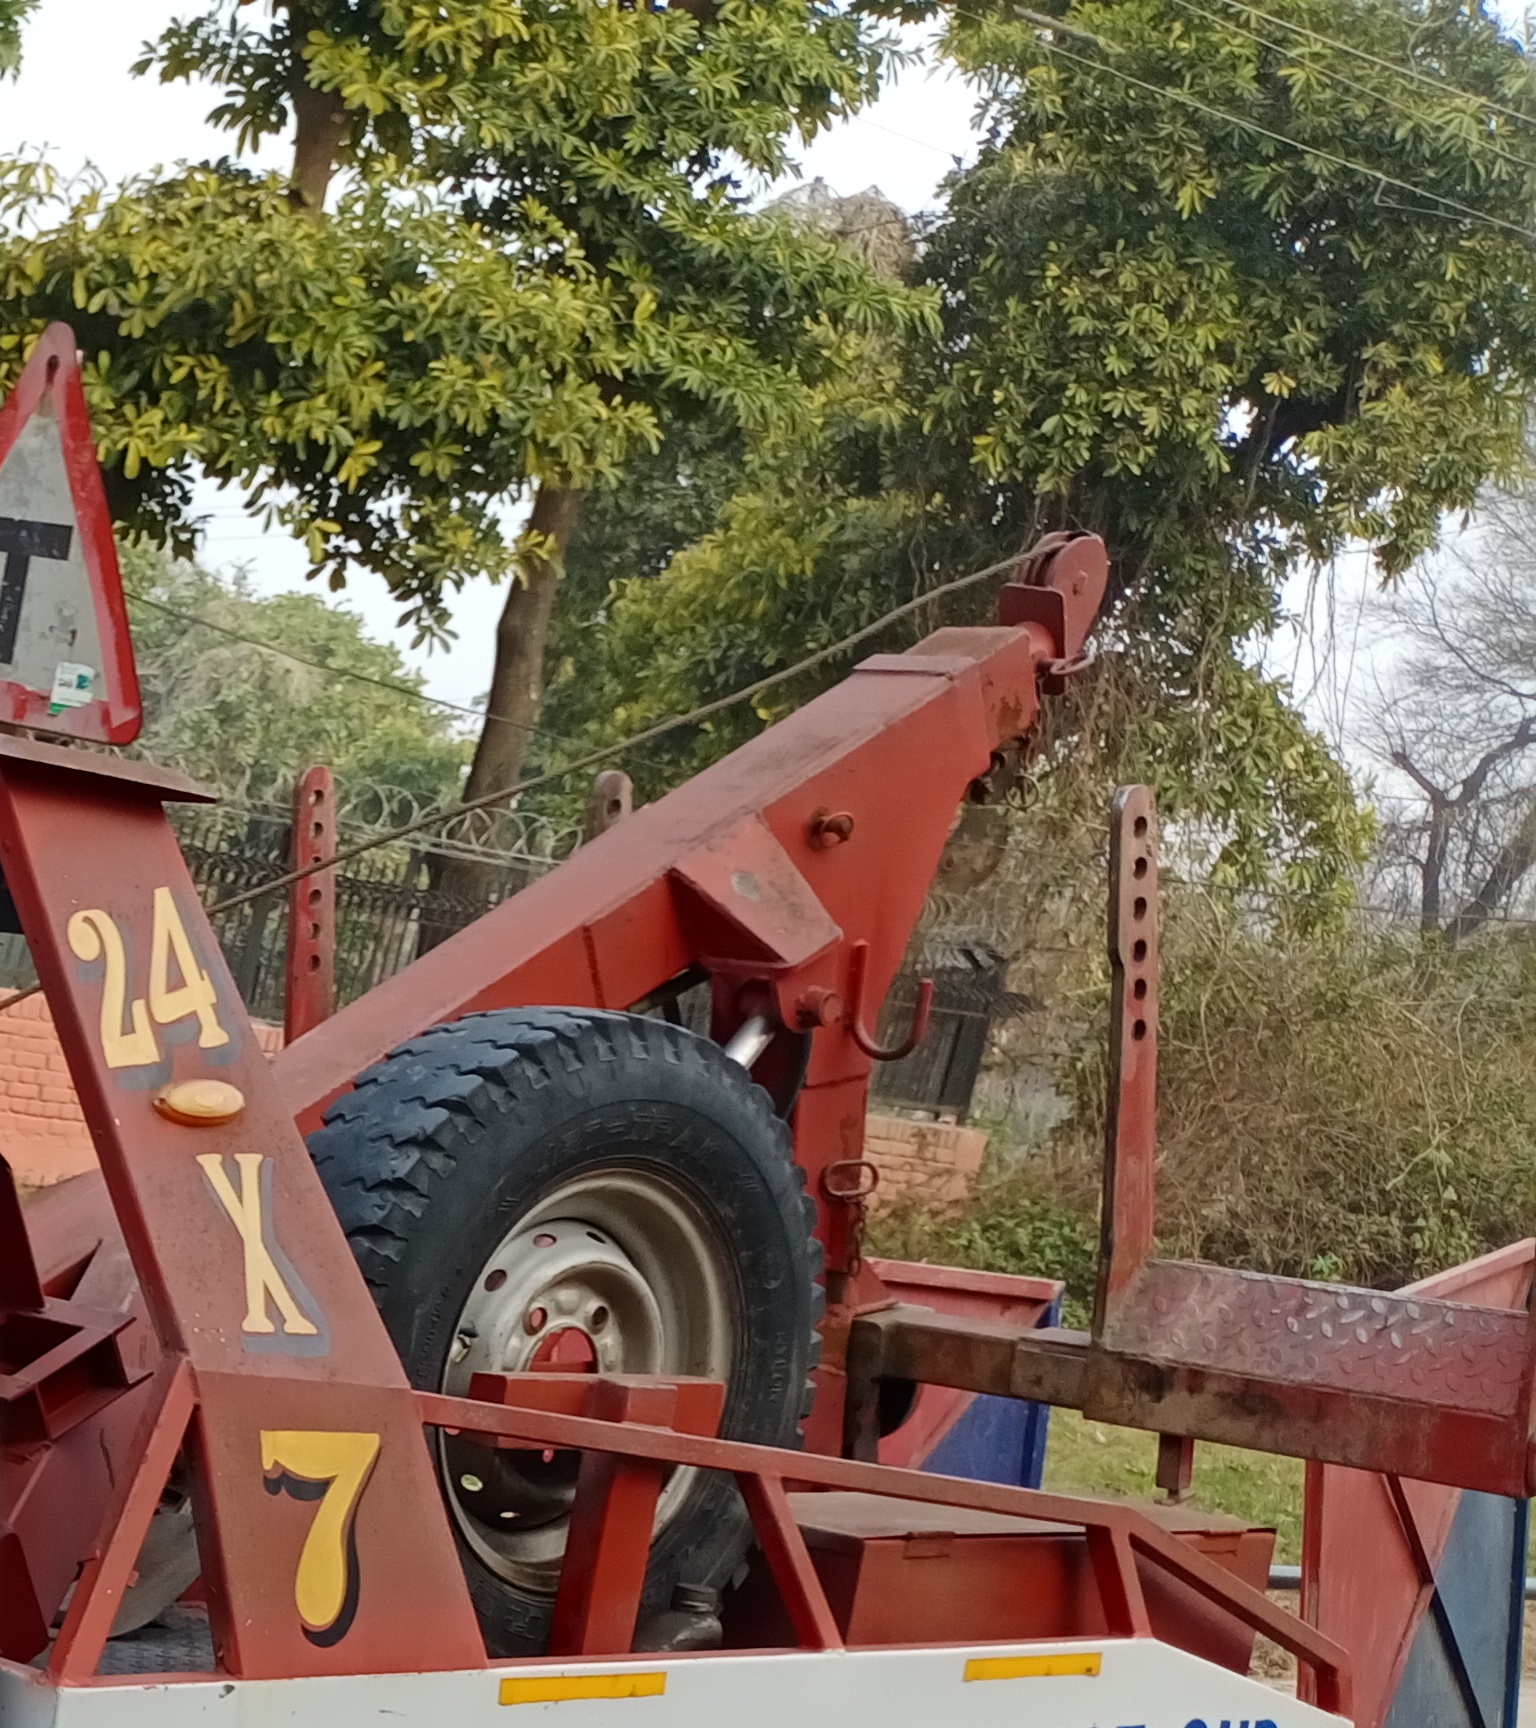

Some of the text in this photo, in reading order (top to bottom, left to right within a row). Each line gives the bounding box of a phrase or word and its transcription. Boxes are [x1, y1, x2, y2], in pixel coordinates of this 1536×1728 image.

[67, 886, 230, 1069] 24
[195, 1153, 319, 1335] X
[260, 1430, 381, 1627] 7
